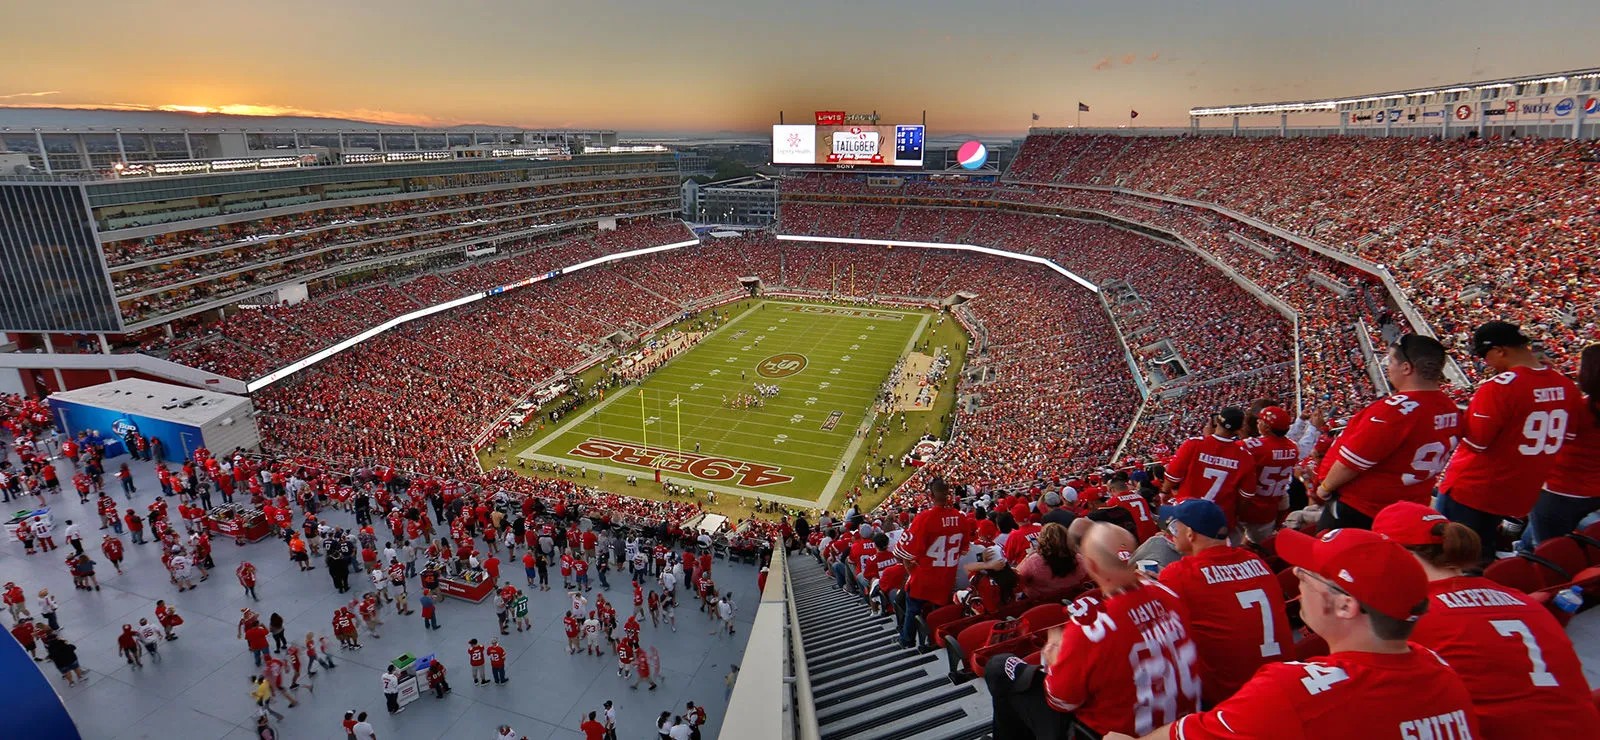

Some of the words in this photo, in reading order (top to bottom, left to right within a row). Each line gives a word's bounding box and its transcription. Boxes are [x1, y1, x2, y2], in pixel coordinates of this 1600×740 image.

[1385, 394, 1420, 416] 94
[1518, 408, 1569, 456] 99
[567, 437, 795, 488] 49ERS
[1203, 467, 1229, 503] 7
[1256, 465, 1293, 497] 52
[941, 516, 960, 528] LOTT
[1129, 500, 1149, 522] 7
[37, 526, 48, 534] 11
[926, 532, 965, 568] 42
[518, 603, 527, 612] 11
[585, 625, 596, 633] 23
[1235, 588, 1282, 657] 7
[472, 652, 481, 661] 21
[619, 650, 627, 659] 21
[1487, 619, 1560, 687] 7
[1399, 709, 1473, 740] SMITH
